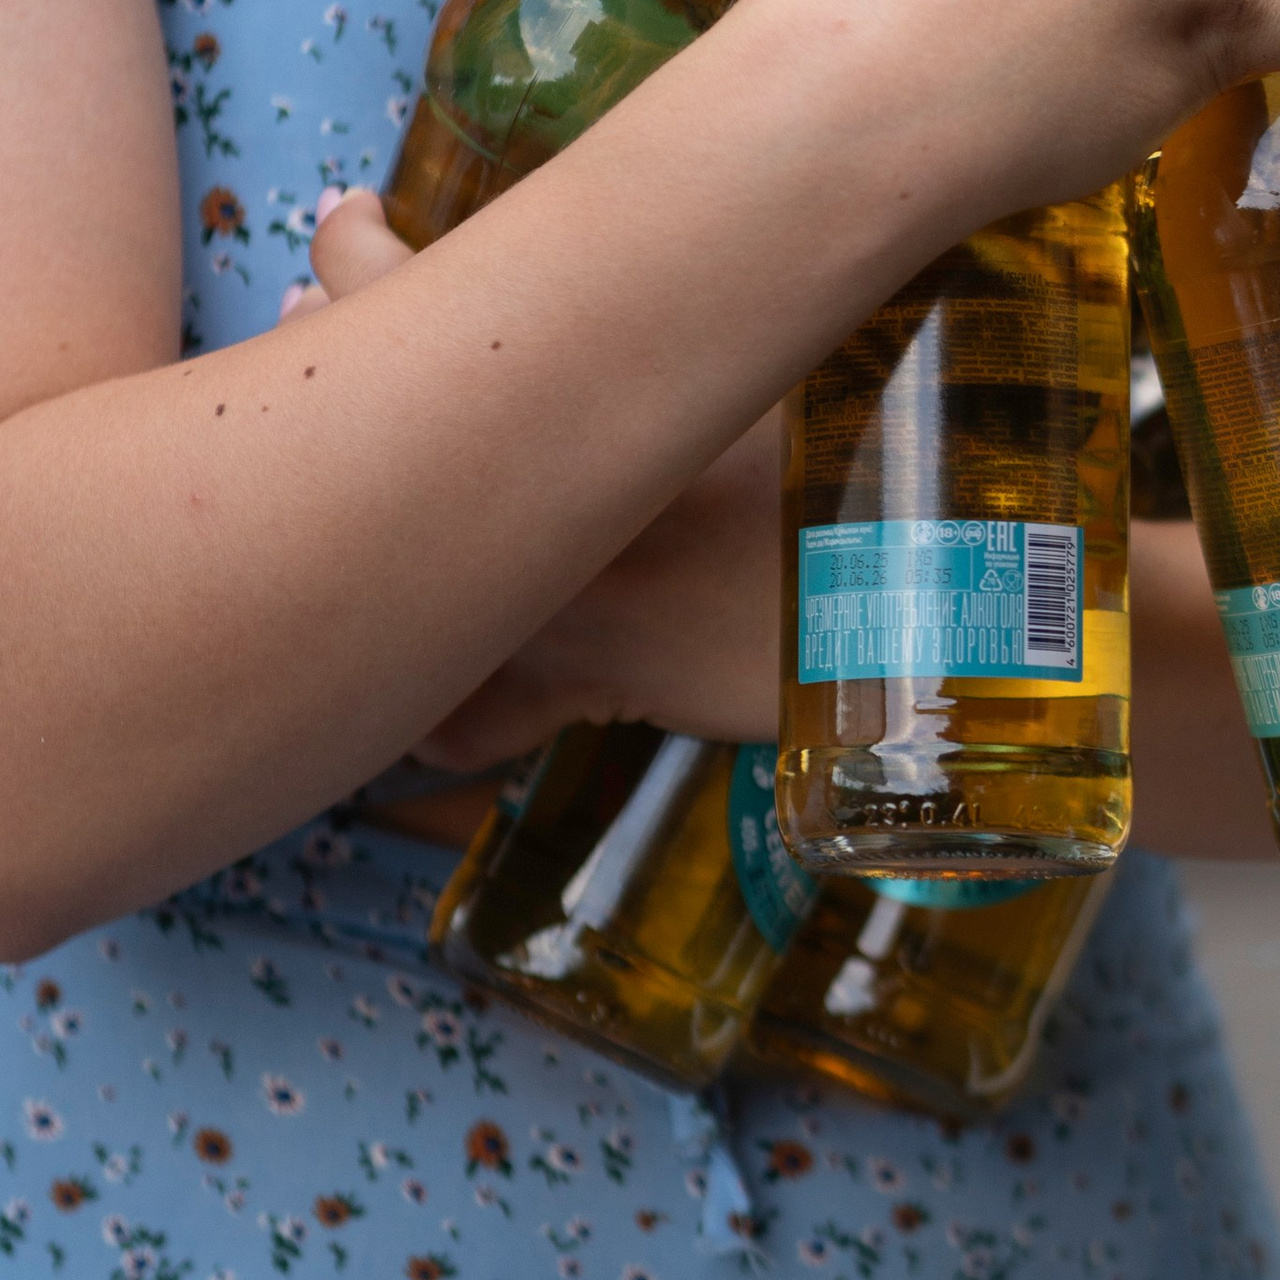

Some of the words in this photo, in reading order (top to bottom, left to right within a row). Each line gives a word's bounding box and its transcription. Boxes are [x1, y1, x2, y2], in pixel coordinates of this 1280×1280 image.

[939, 526, 957, 540] 18+
[905, 567, 953, 586] 05:35
[1064, 540, 1076, 593] 025779
[805, 594, 864, 634] ЧРЕЗМЕРНОЕ
[865, 591, 957, 628] УПОТРЕБЛЕНИЕ
[960, 591, 1023, 629] АЛКОГОЛЯ
[1065, 597, 1076, 649] 600721
[804, 629, 851, 672] ВРЕДИТ
[857, 626, 923, 665] ВАШЕМУ
[931, 626, 1023, 668] ЗДОРОВЬЮ
[1065, 658, 1076, 667] 4
